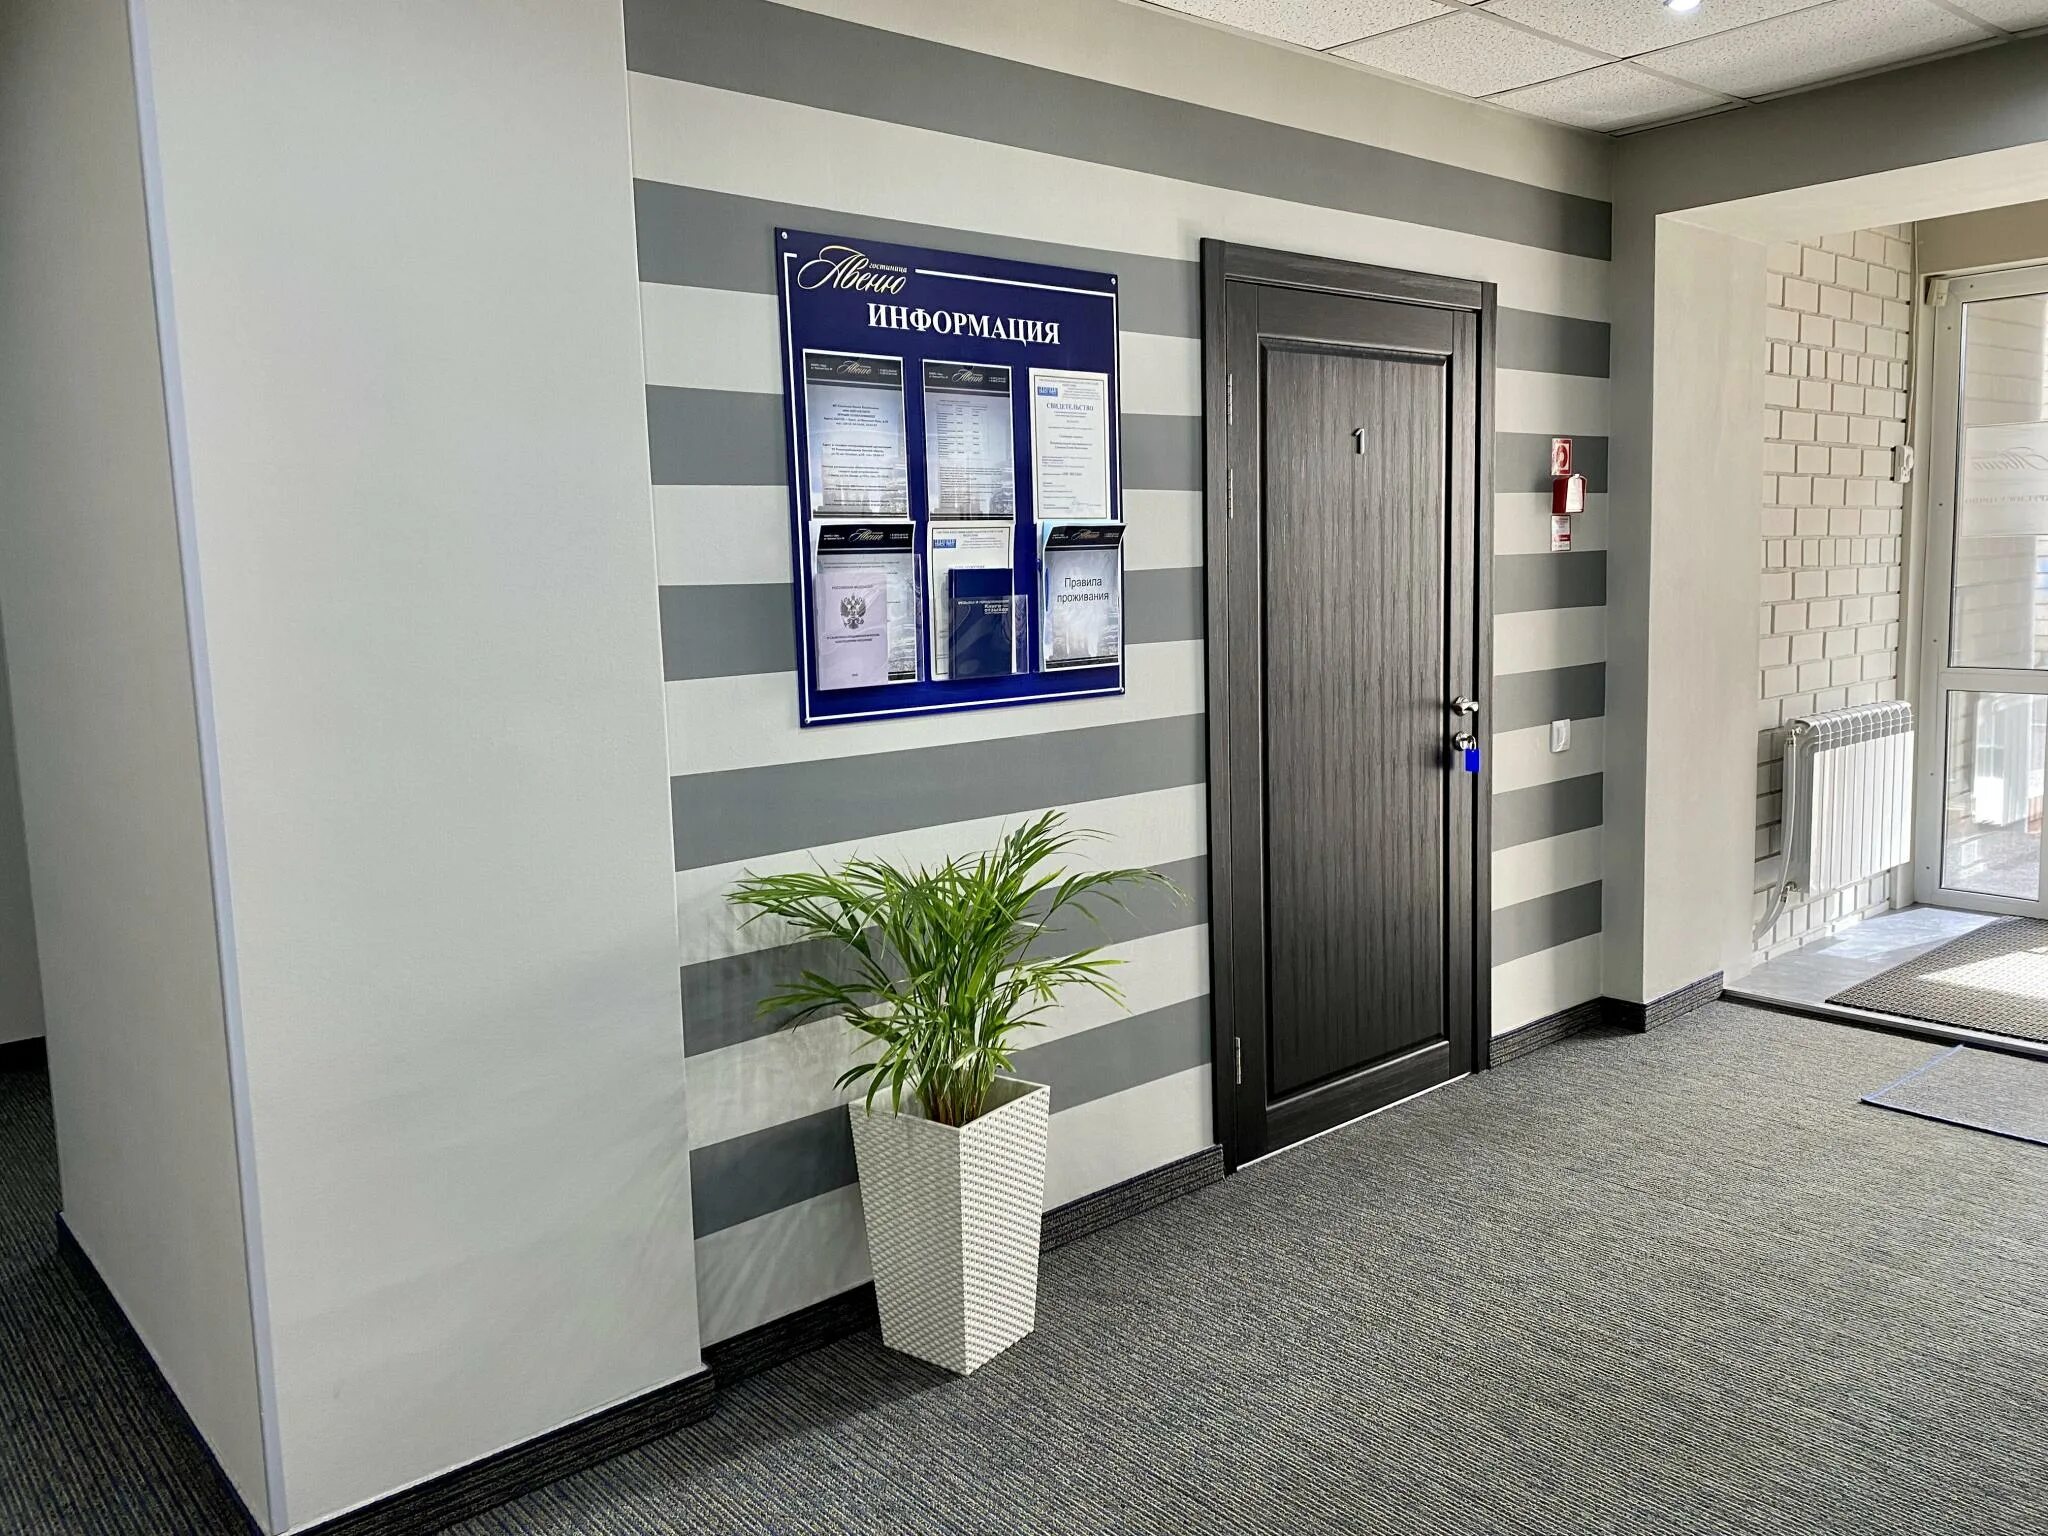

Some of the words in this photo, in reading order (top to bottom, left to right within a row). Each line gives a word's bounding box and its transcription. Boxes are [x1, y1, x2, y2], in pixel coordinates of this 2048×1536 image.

[797, 245, 907, 295] Авеню
[868, 262, 908, 273] гостиница
[866, 303, 1060, 347] ИНФОРМАЦИЯ
[1351, 427, 1365, 455] 1
[1064, 577, 1103, 589] Правила
[1057, 591, 1109, 604] проживания
